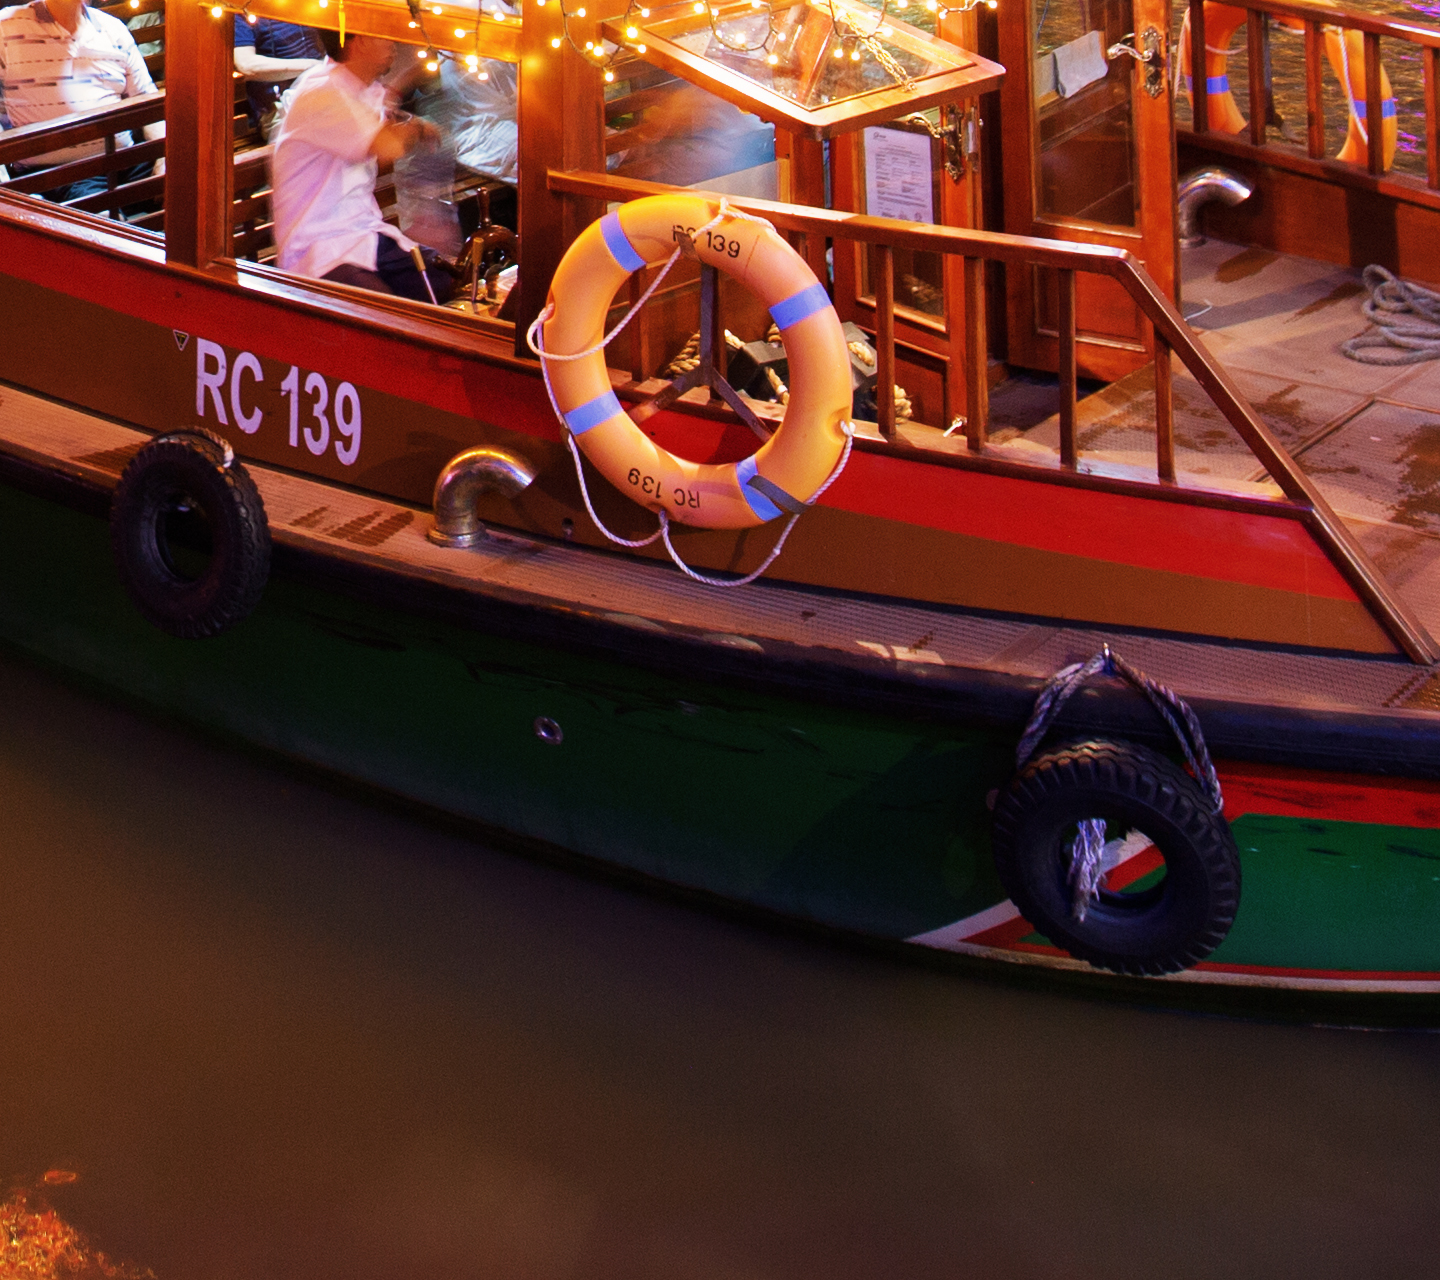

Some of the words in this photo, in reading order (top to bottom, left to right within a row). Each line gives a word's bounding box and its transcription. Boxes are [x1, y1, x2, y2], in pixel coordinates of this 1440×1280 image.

[707, 231, 740, 258] 139
[196, 337, 264, 434] RC
[280, 365, 362, 466] 139
[628, 468, 661, 498] 139
[674, 488, 700, 508] RC
